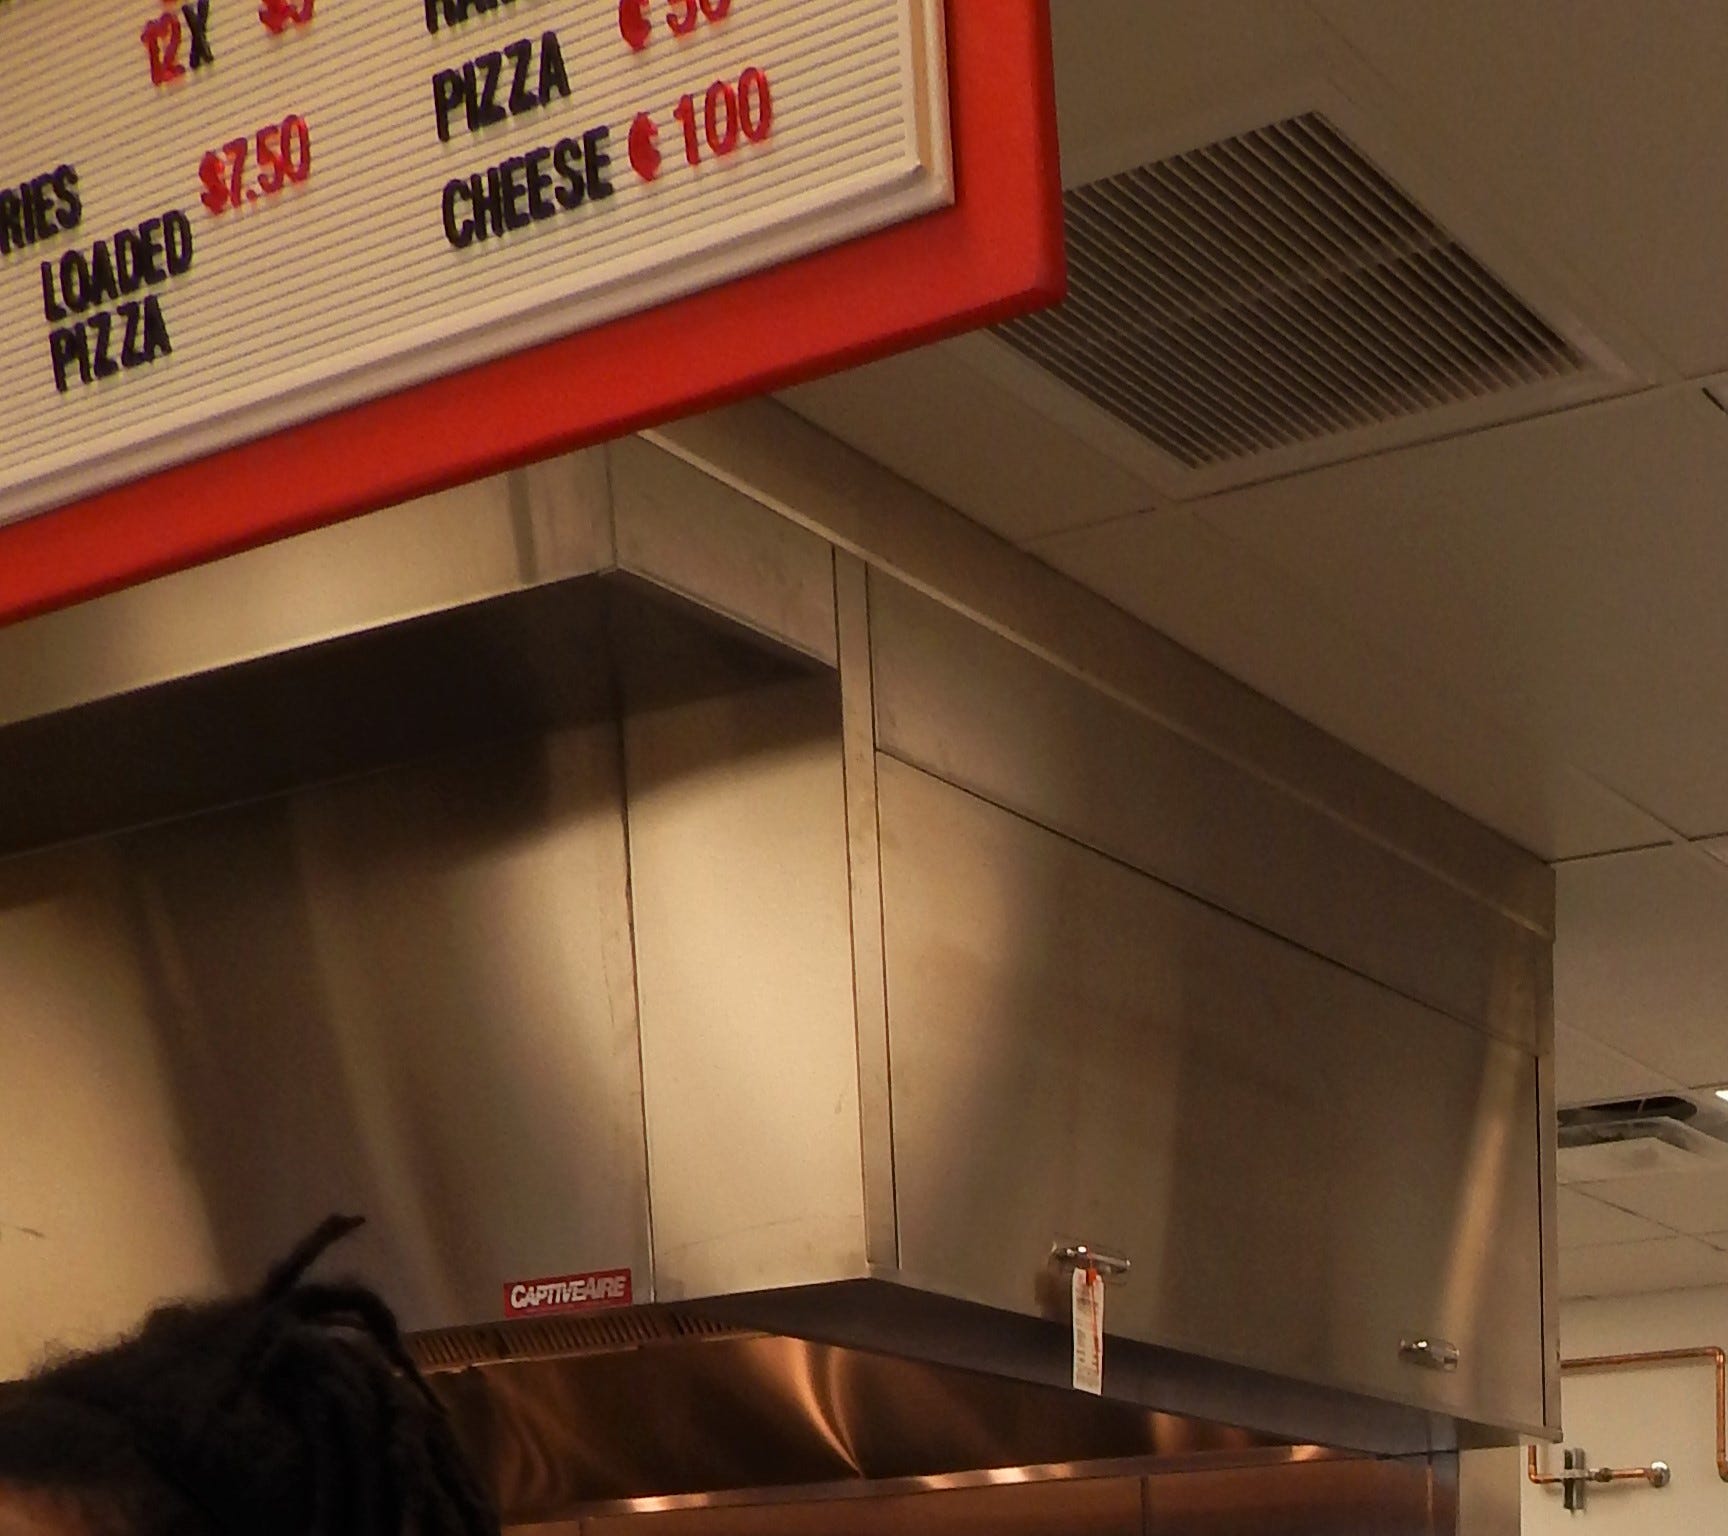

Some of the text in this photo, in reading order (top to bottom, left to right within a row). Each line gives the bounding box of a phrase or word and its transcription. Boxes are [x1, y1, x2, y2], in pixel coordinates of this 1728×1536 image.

[433, 31, 571, 142] PIZZA
[199, 114, 311, 215] $7.50
[442, 125, 614, 248] CHEESE
[41, 209, 193, 322] LOADED
[49, 294, 173, 393] PIZZA
